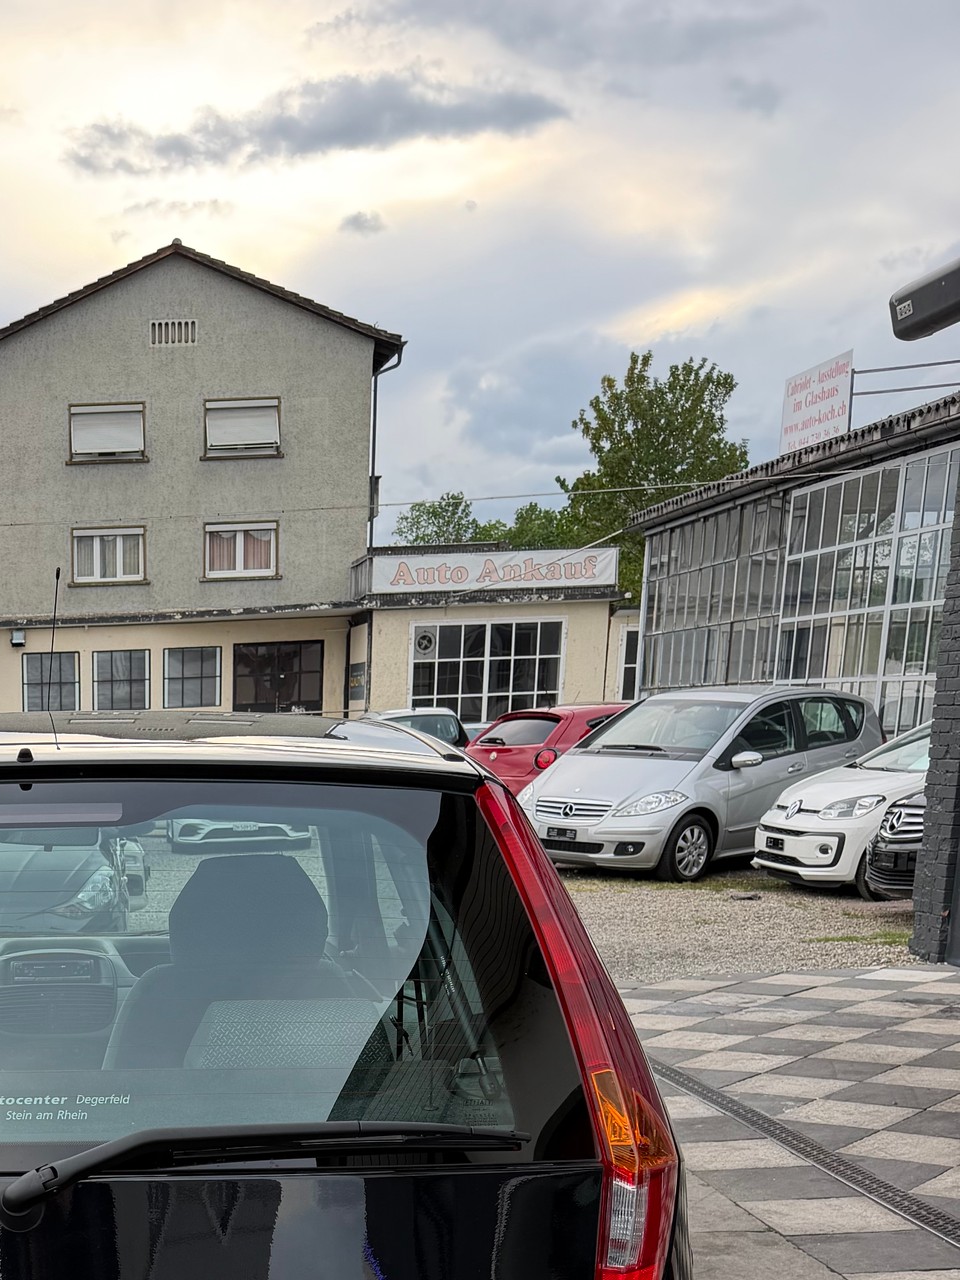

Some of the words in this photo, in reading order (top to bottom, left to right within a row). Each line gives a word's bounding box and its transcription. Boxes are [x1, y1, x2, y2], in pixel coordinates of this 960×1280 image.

[804, 386, 839, 408] Glashaus
[390, 561, 469, 586] Auto
[476, 555, 598, 583] Ankauf
[76, 1093, 131, 1107] Degerfeld
[5, 1109, 33, 1120] Stein
[35, 1111, 54, 1120] am
[57, 1109, 88, 1120] Rhein
